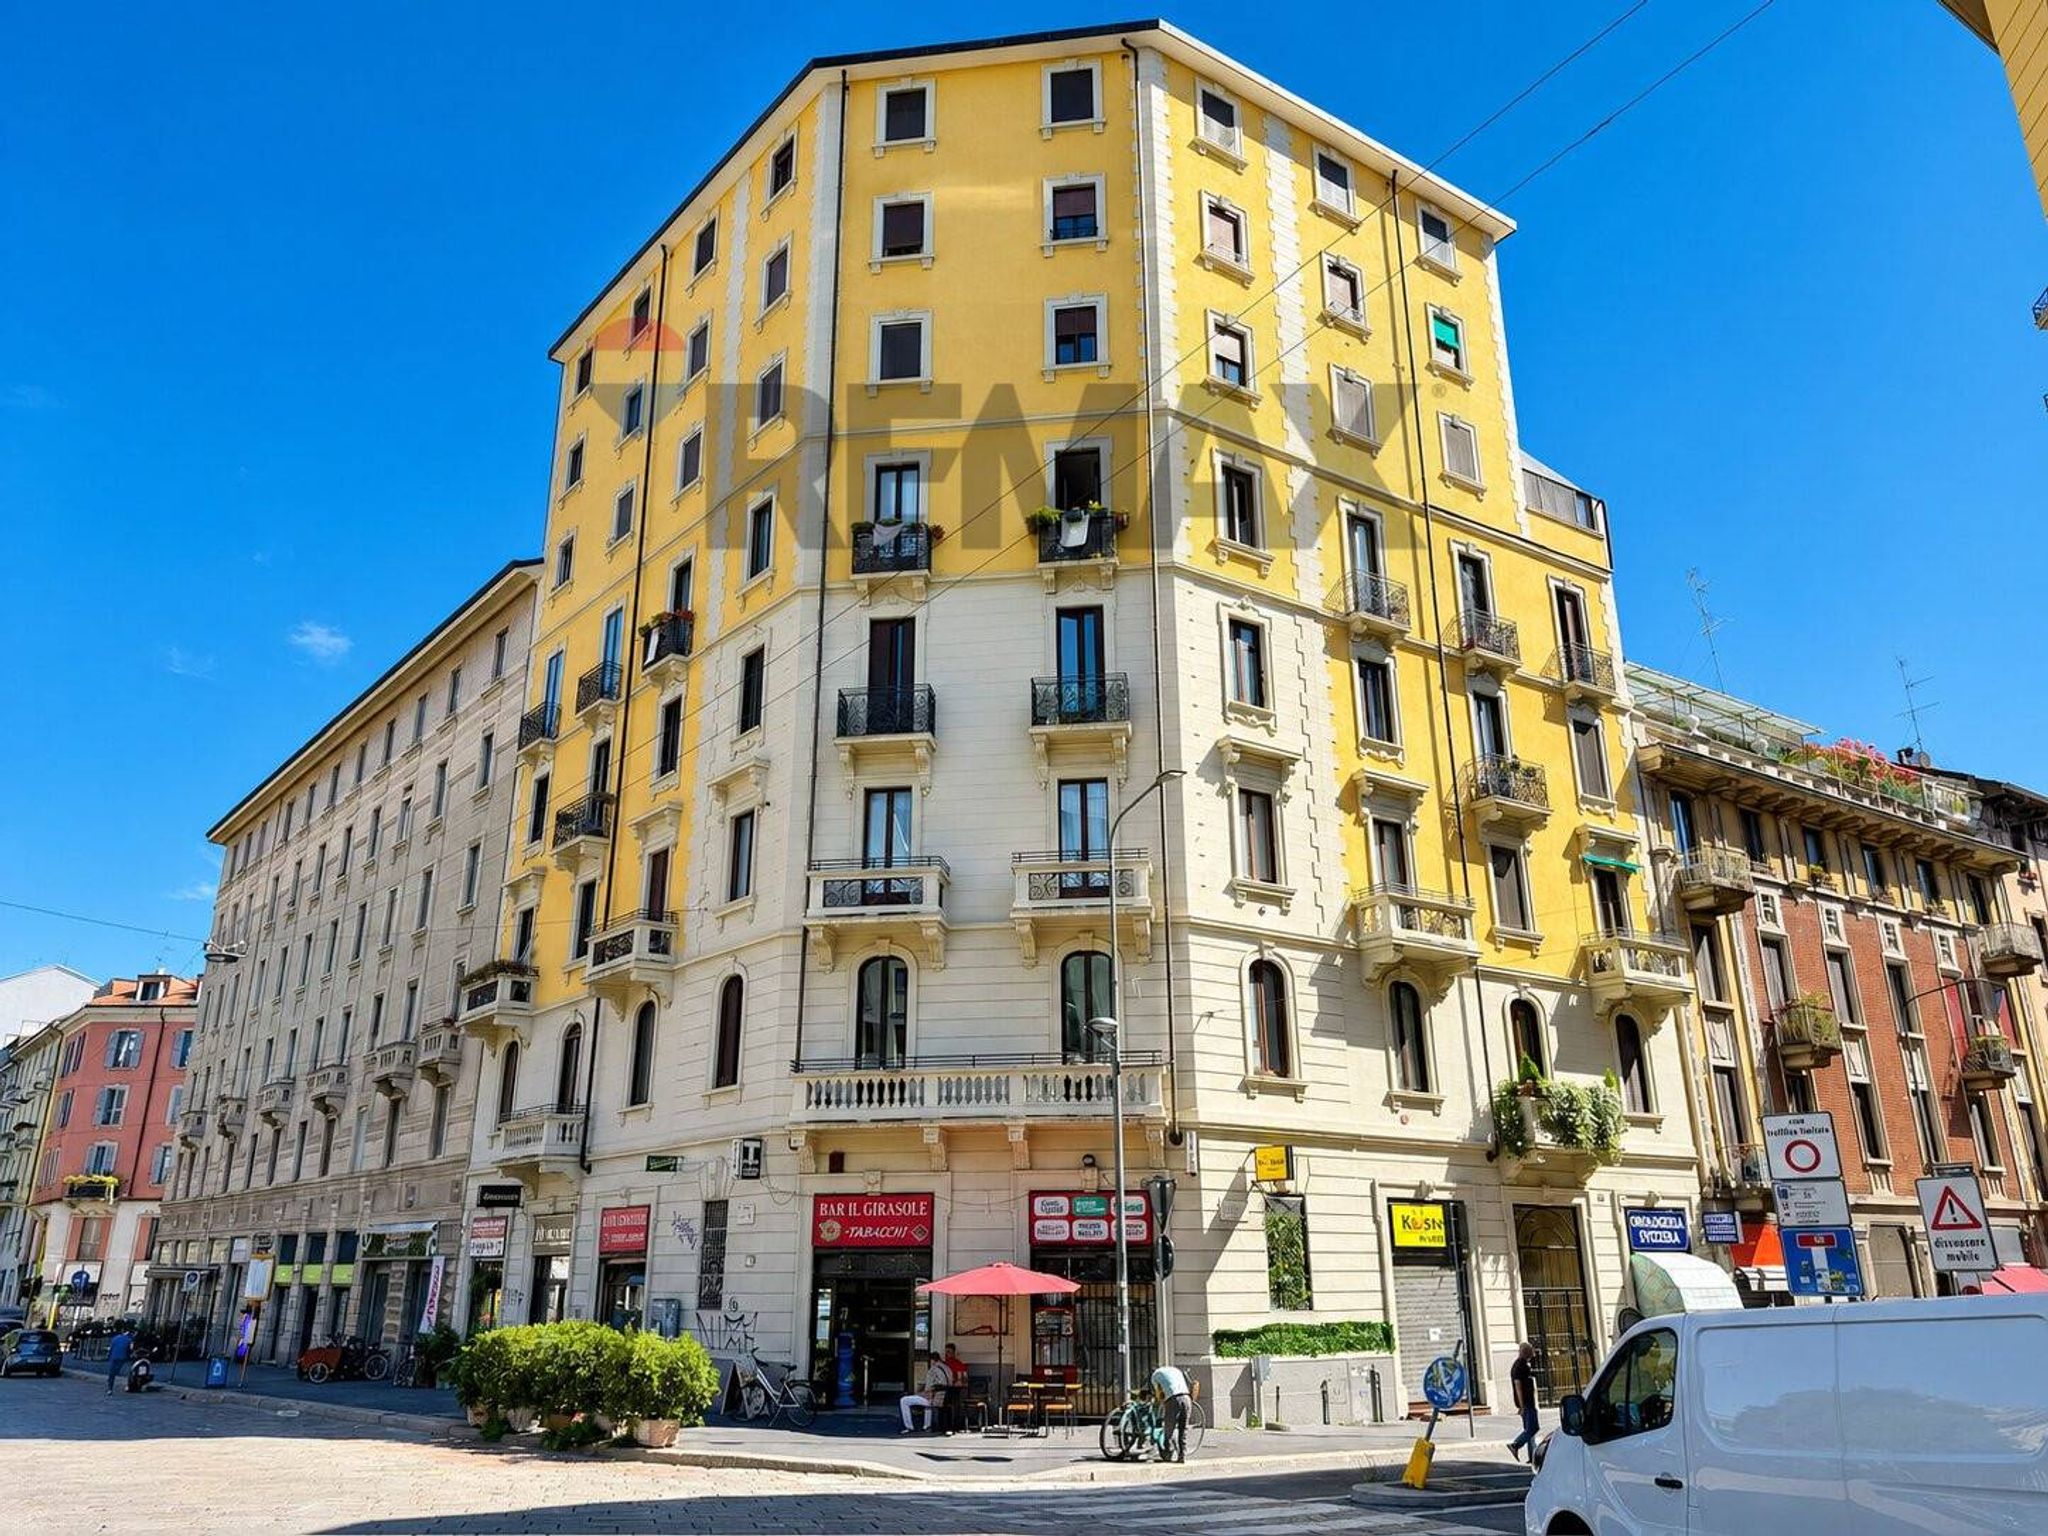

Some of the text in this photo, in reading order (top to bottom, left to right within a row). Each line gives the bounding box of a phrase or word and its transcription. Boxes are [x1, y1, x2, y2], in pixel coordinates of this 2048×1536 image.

[819, 1201, 928, 1217] BAR IL GIRASOLE
[847, 1226, 909, 1239] TABACCHI
